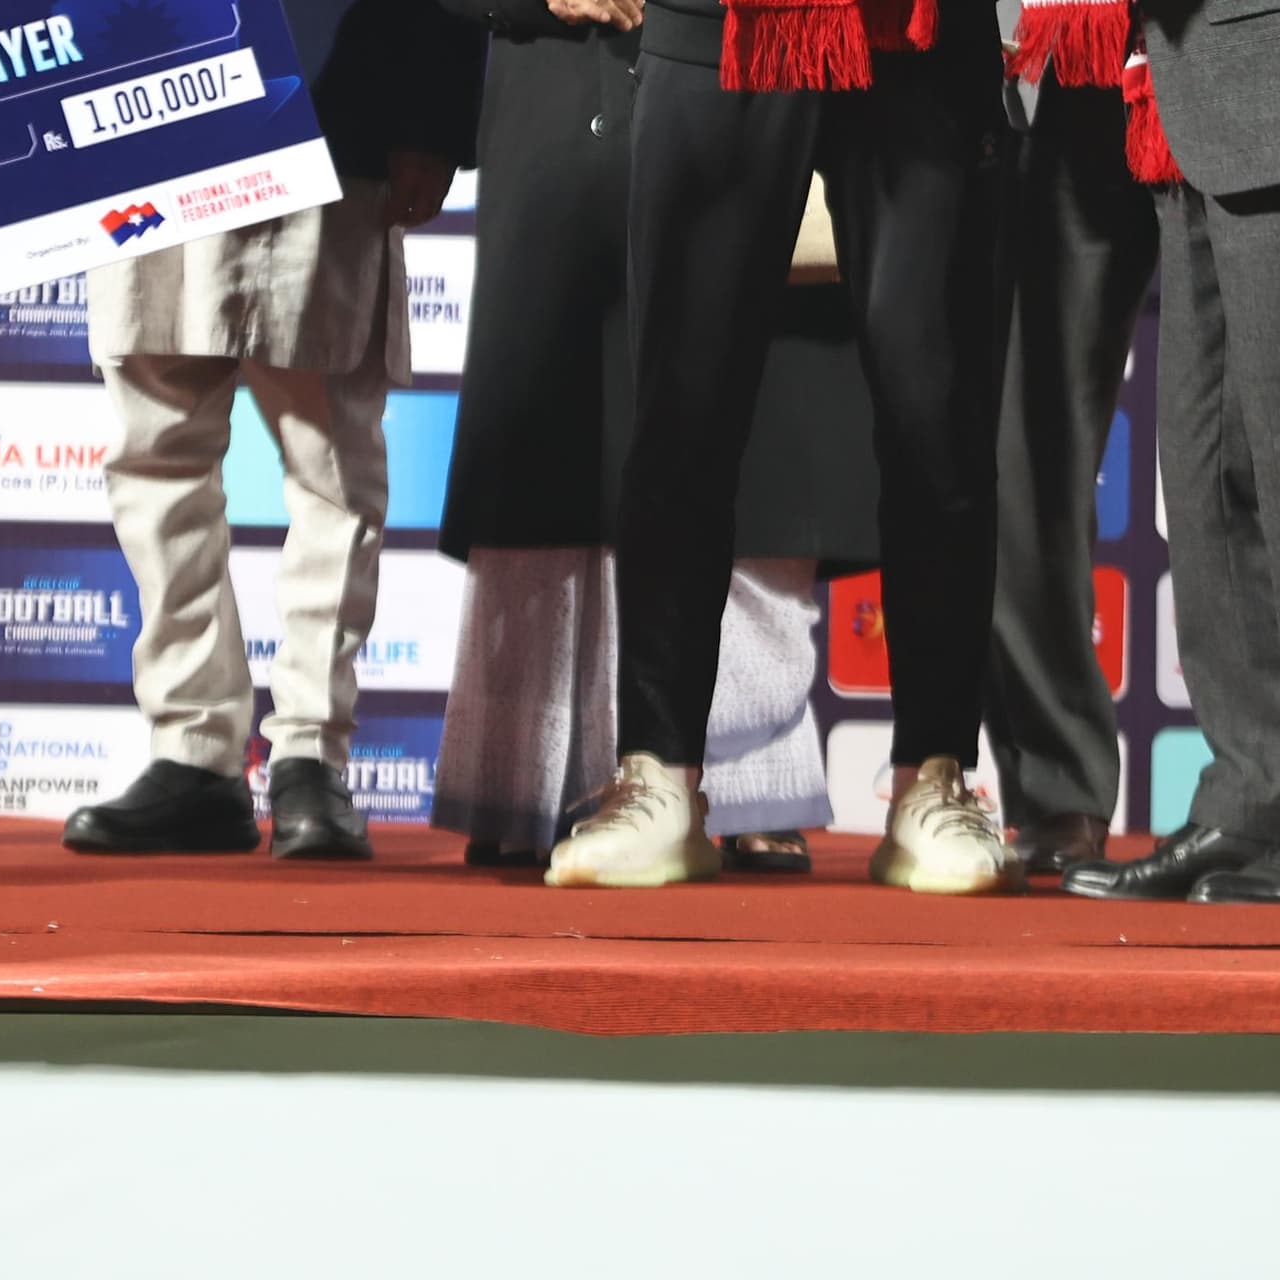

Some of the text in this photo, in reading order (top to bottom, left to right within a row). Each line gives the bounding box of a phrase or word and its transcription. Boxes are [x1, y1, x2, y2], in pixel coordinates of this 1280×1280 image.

[43, 62, 243, 152] Rs. 1,00,000/-
[176, 169, 273, 208] NATIONAL YOUTH
[181, 182, 291, 224] FEDERATION NEPAL
[411, 303, 463, 324] NEPAL
[35, 443, 109, 470] LINK
[371, 639, 421, 664] LIFE
